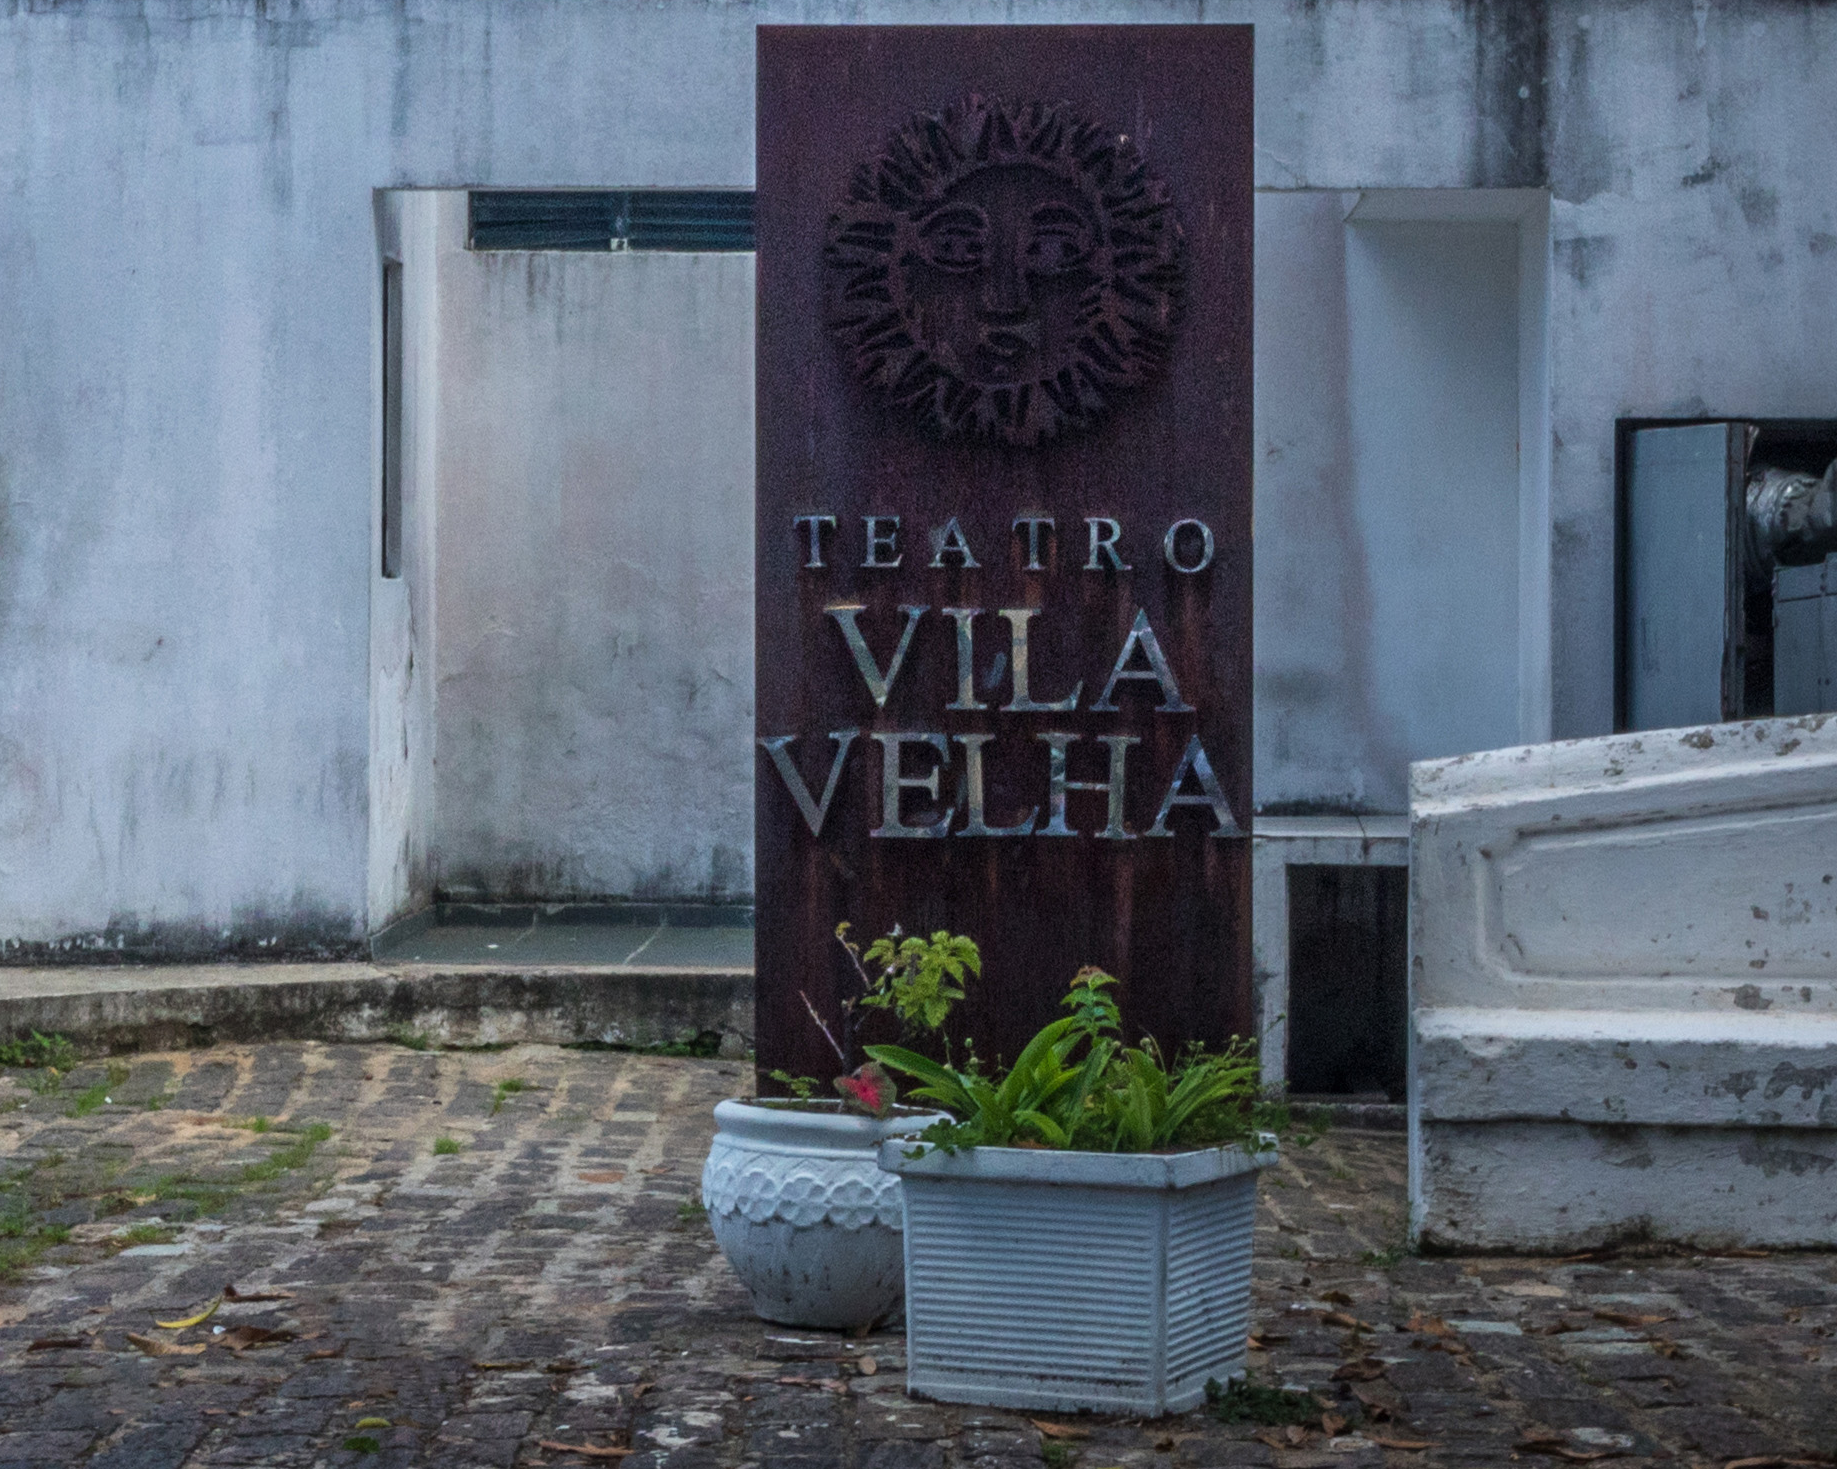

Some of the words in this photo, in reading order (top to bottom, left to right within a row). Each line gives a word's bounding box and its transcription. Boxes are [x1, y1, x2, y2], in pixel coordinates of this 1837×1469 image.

[793, 514, 1215, 573] TEATRO
[823, 604, 1198, 713] VILA
[758, 731, 1254, 839] VELHA
